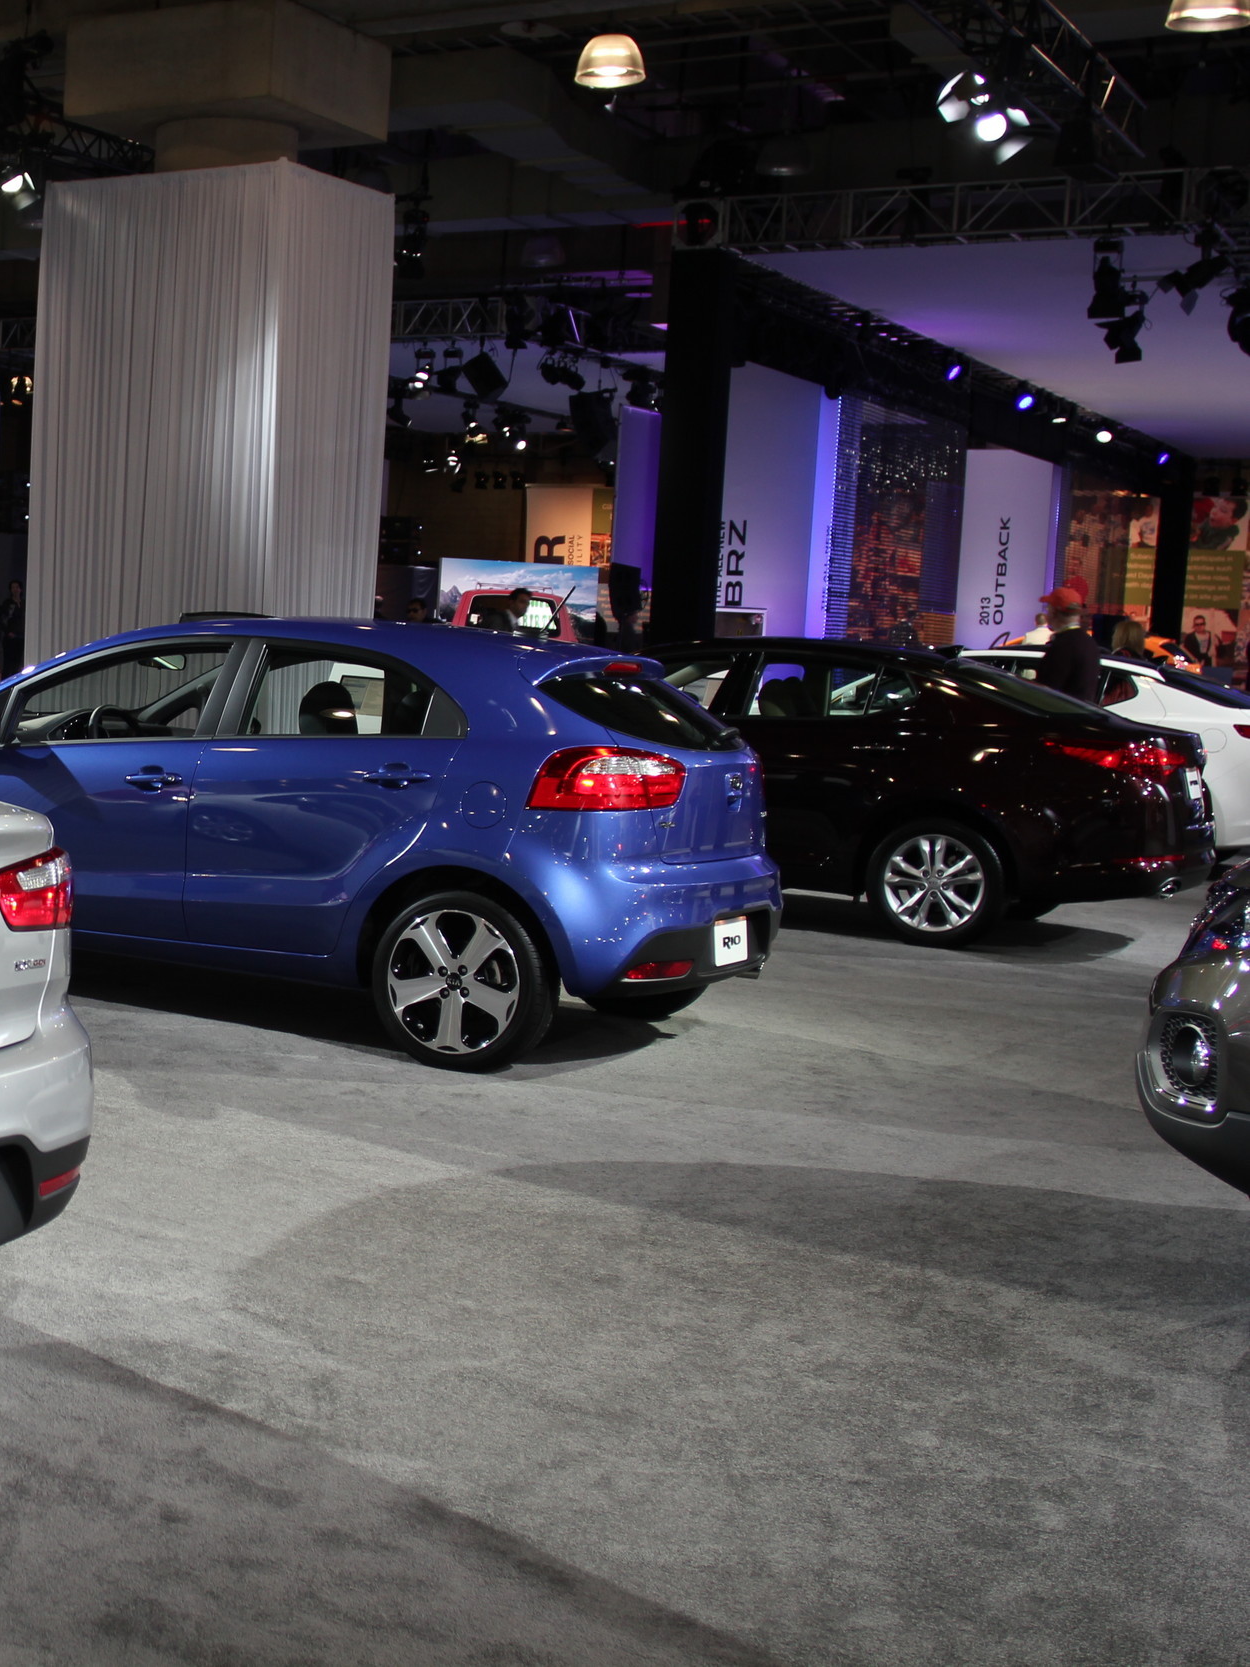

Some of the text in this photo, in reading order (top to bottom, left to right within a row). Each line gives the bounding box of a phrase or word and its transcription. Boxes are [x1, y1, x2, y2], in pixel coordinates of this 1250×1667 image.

[567, 535, 575, 565] SOCIAL
[725, 519, 747, 606] BRZ
[993, 516, 1011, 625] OUTBACK
[979, 597, 991, 625] 2013
[722, 934, 741, 949] RIO
